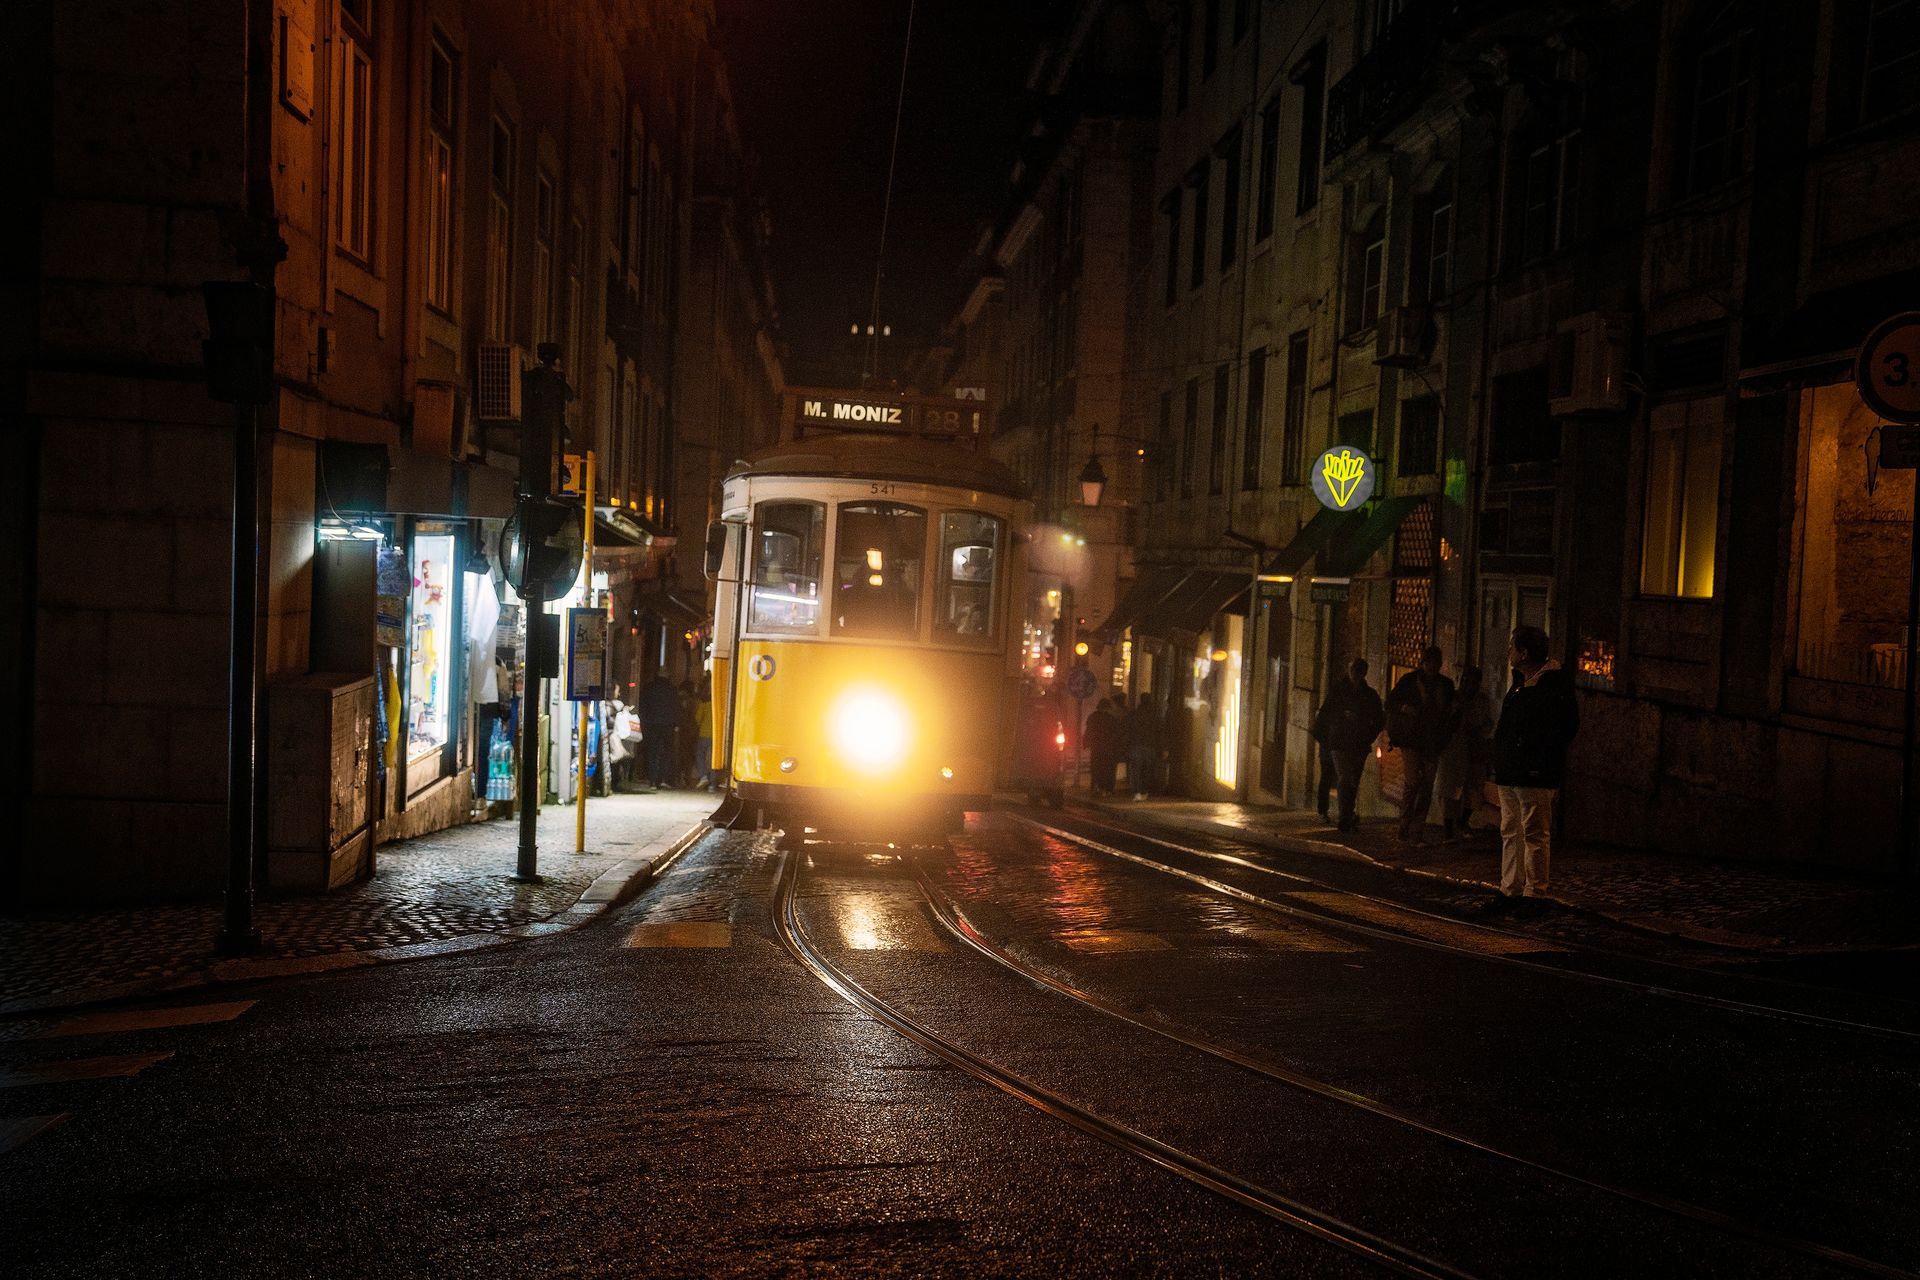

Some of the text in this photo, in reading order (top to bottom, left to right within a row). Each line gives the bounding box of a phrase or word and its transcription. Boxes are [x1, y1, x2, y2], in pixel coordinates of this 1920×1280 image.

[804, 400, 902, 424] M. MONIZ
[871, 484, 895, 496] 541
